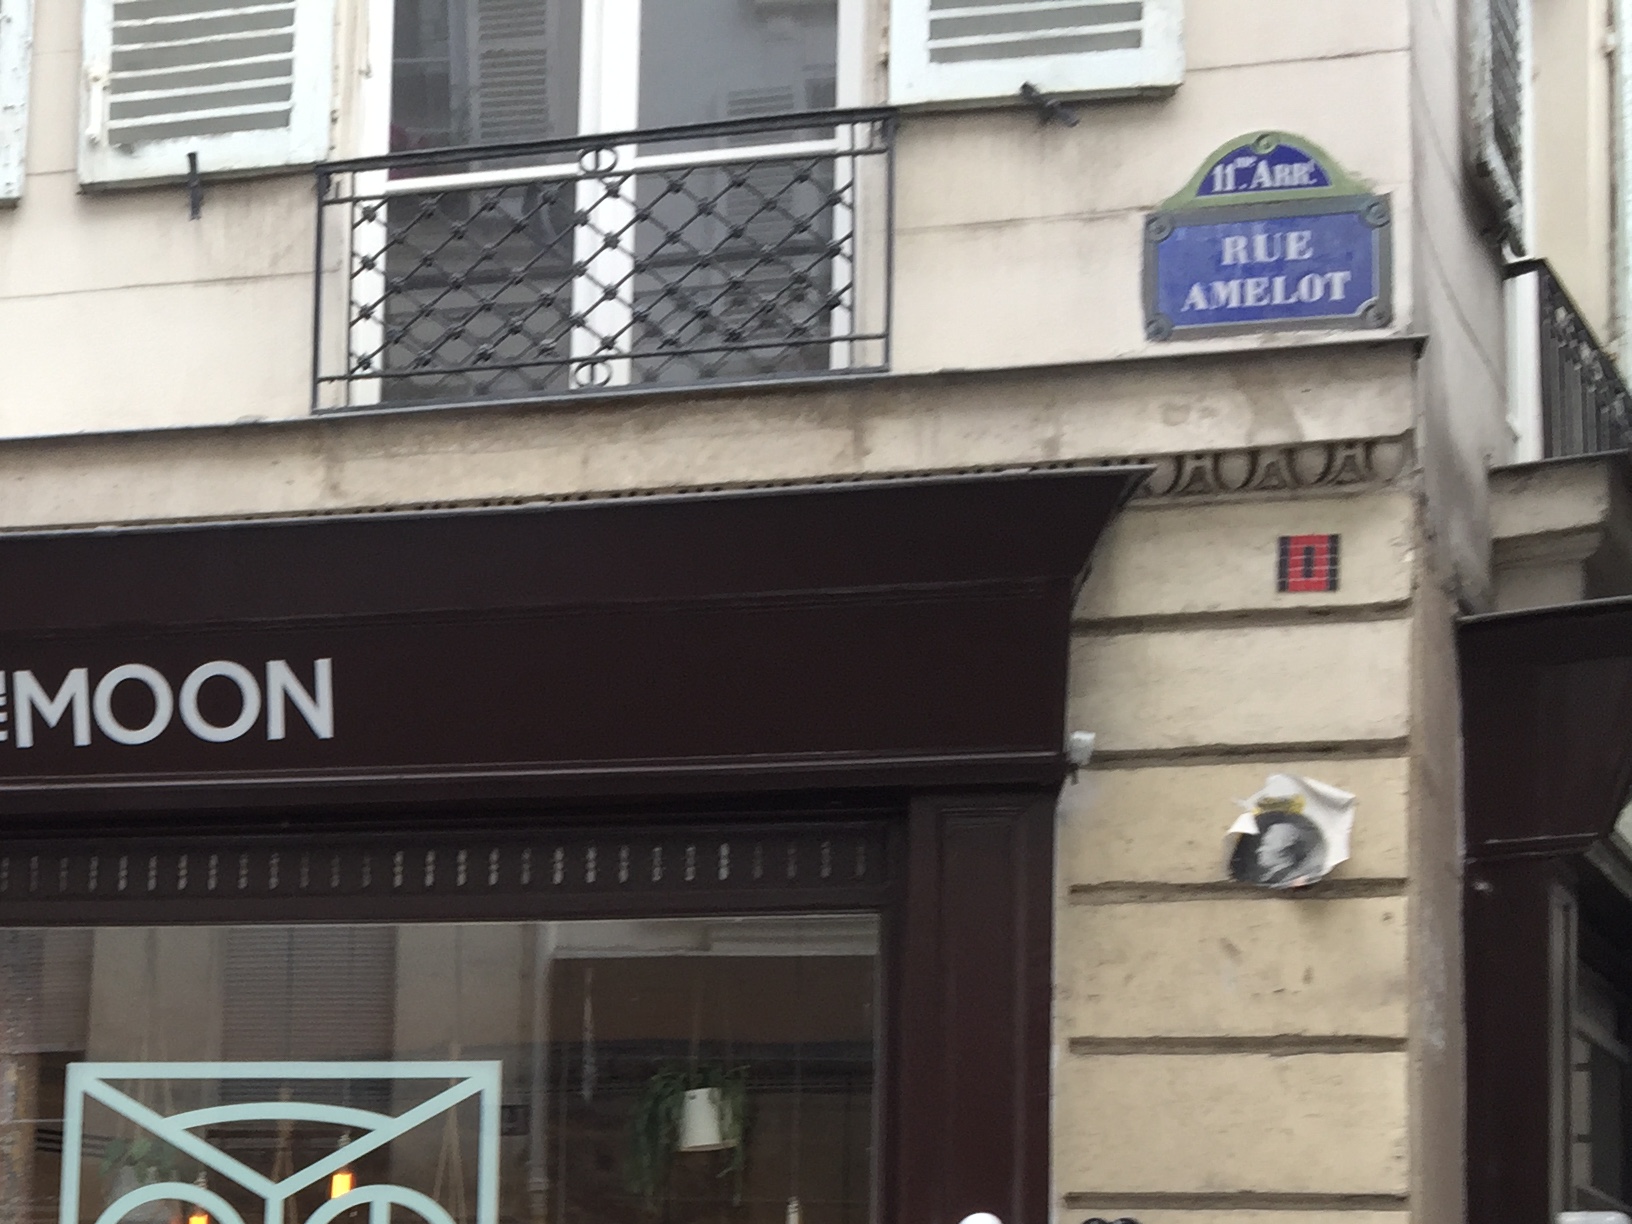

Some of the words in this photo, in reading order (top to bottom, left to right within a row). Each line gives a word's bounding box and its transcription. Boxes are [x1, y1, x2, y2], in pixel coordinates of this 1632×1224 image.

[1219, 230, 1315, 267] RUE
[1180, 270, 1352, 313] AMELOT
[13, 657, 335, 748] MOON
